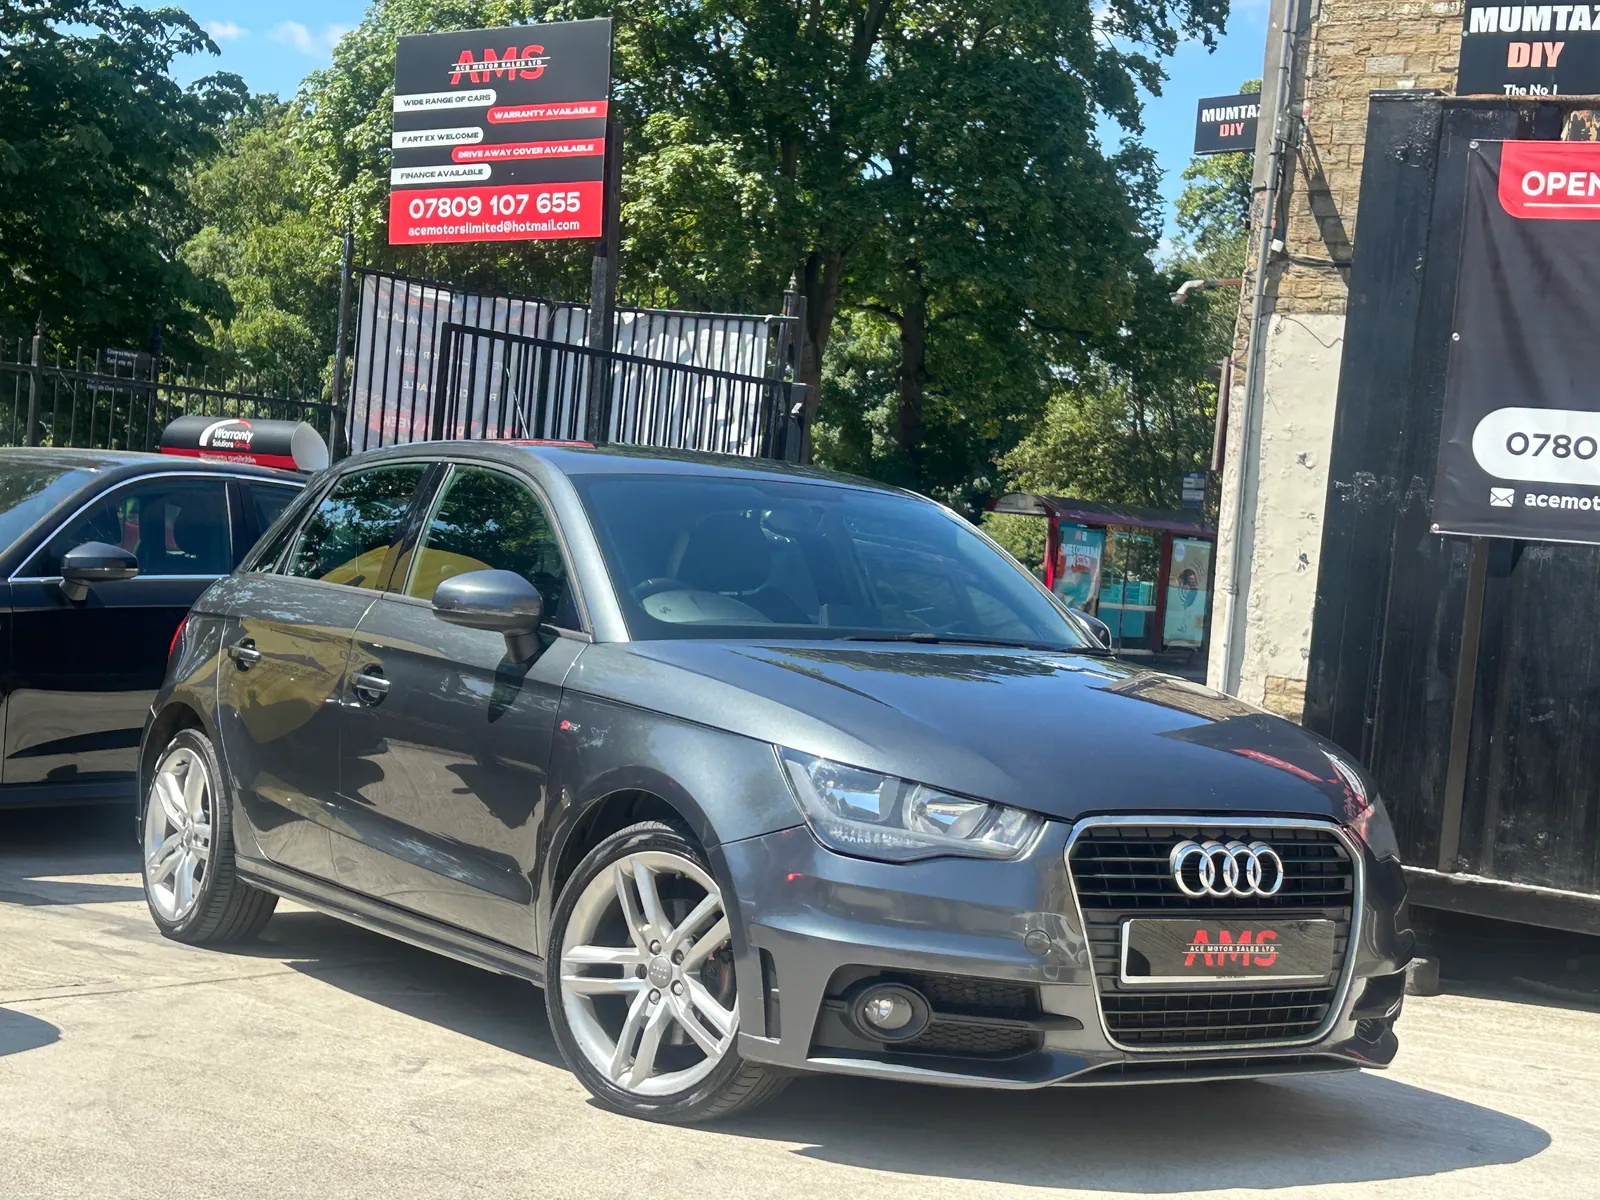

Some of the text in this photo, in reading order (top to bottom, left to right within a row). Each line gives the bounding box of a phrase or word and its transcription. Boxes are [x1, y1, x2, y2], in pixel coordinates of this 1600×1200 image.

[1507, 41, 1565, 68] DIY
[450, 44, 545, 84] AMS
[472, 62, 499, 71] MOTOR
[501, 60, 526, 68] SALES
[1503, 84, 1527, 96] The
[403, 98, 424, 106] WIDE
[425, 97, 454, 105] RANGE
[467, 94, 491, 102] CARS
[494, 106, 597, 119] WARRANTY AVAILABLE
[1219, 122, 1244, 137] DIY
[402, 135, 424, 143] PART
[437, 132, 479, 141] WELCOME
[458, 144, 594, 159] DRIVE AWAY COVER AVAILABLE
[400, 168, 484, 180] FINANCE AVAILABLE
[409, 191, 581, 219] 07809 107 655
[408, 219, 580, 237] acemotorslimited@hotmail.com
[214, 428, 254, 444] Warranty
[1506, 432, 1598, 460] 0780
[1184, 929, 1278, 967] AMS
